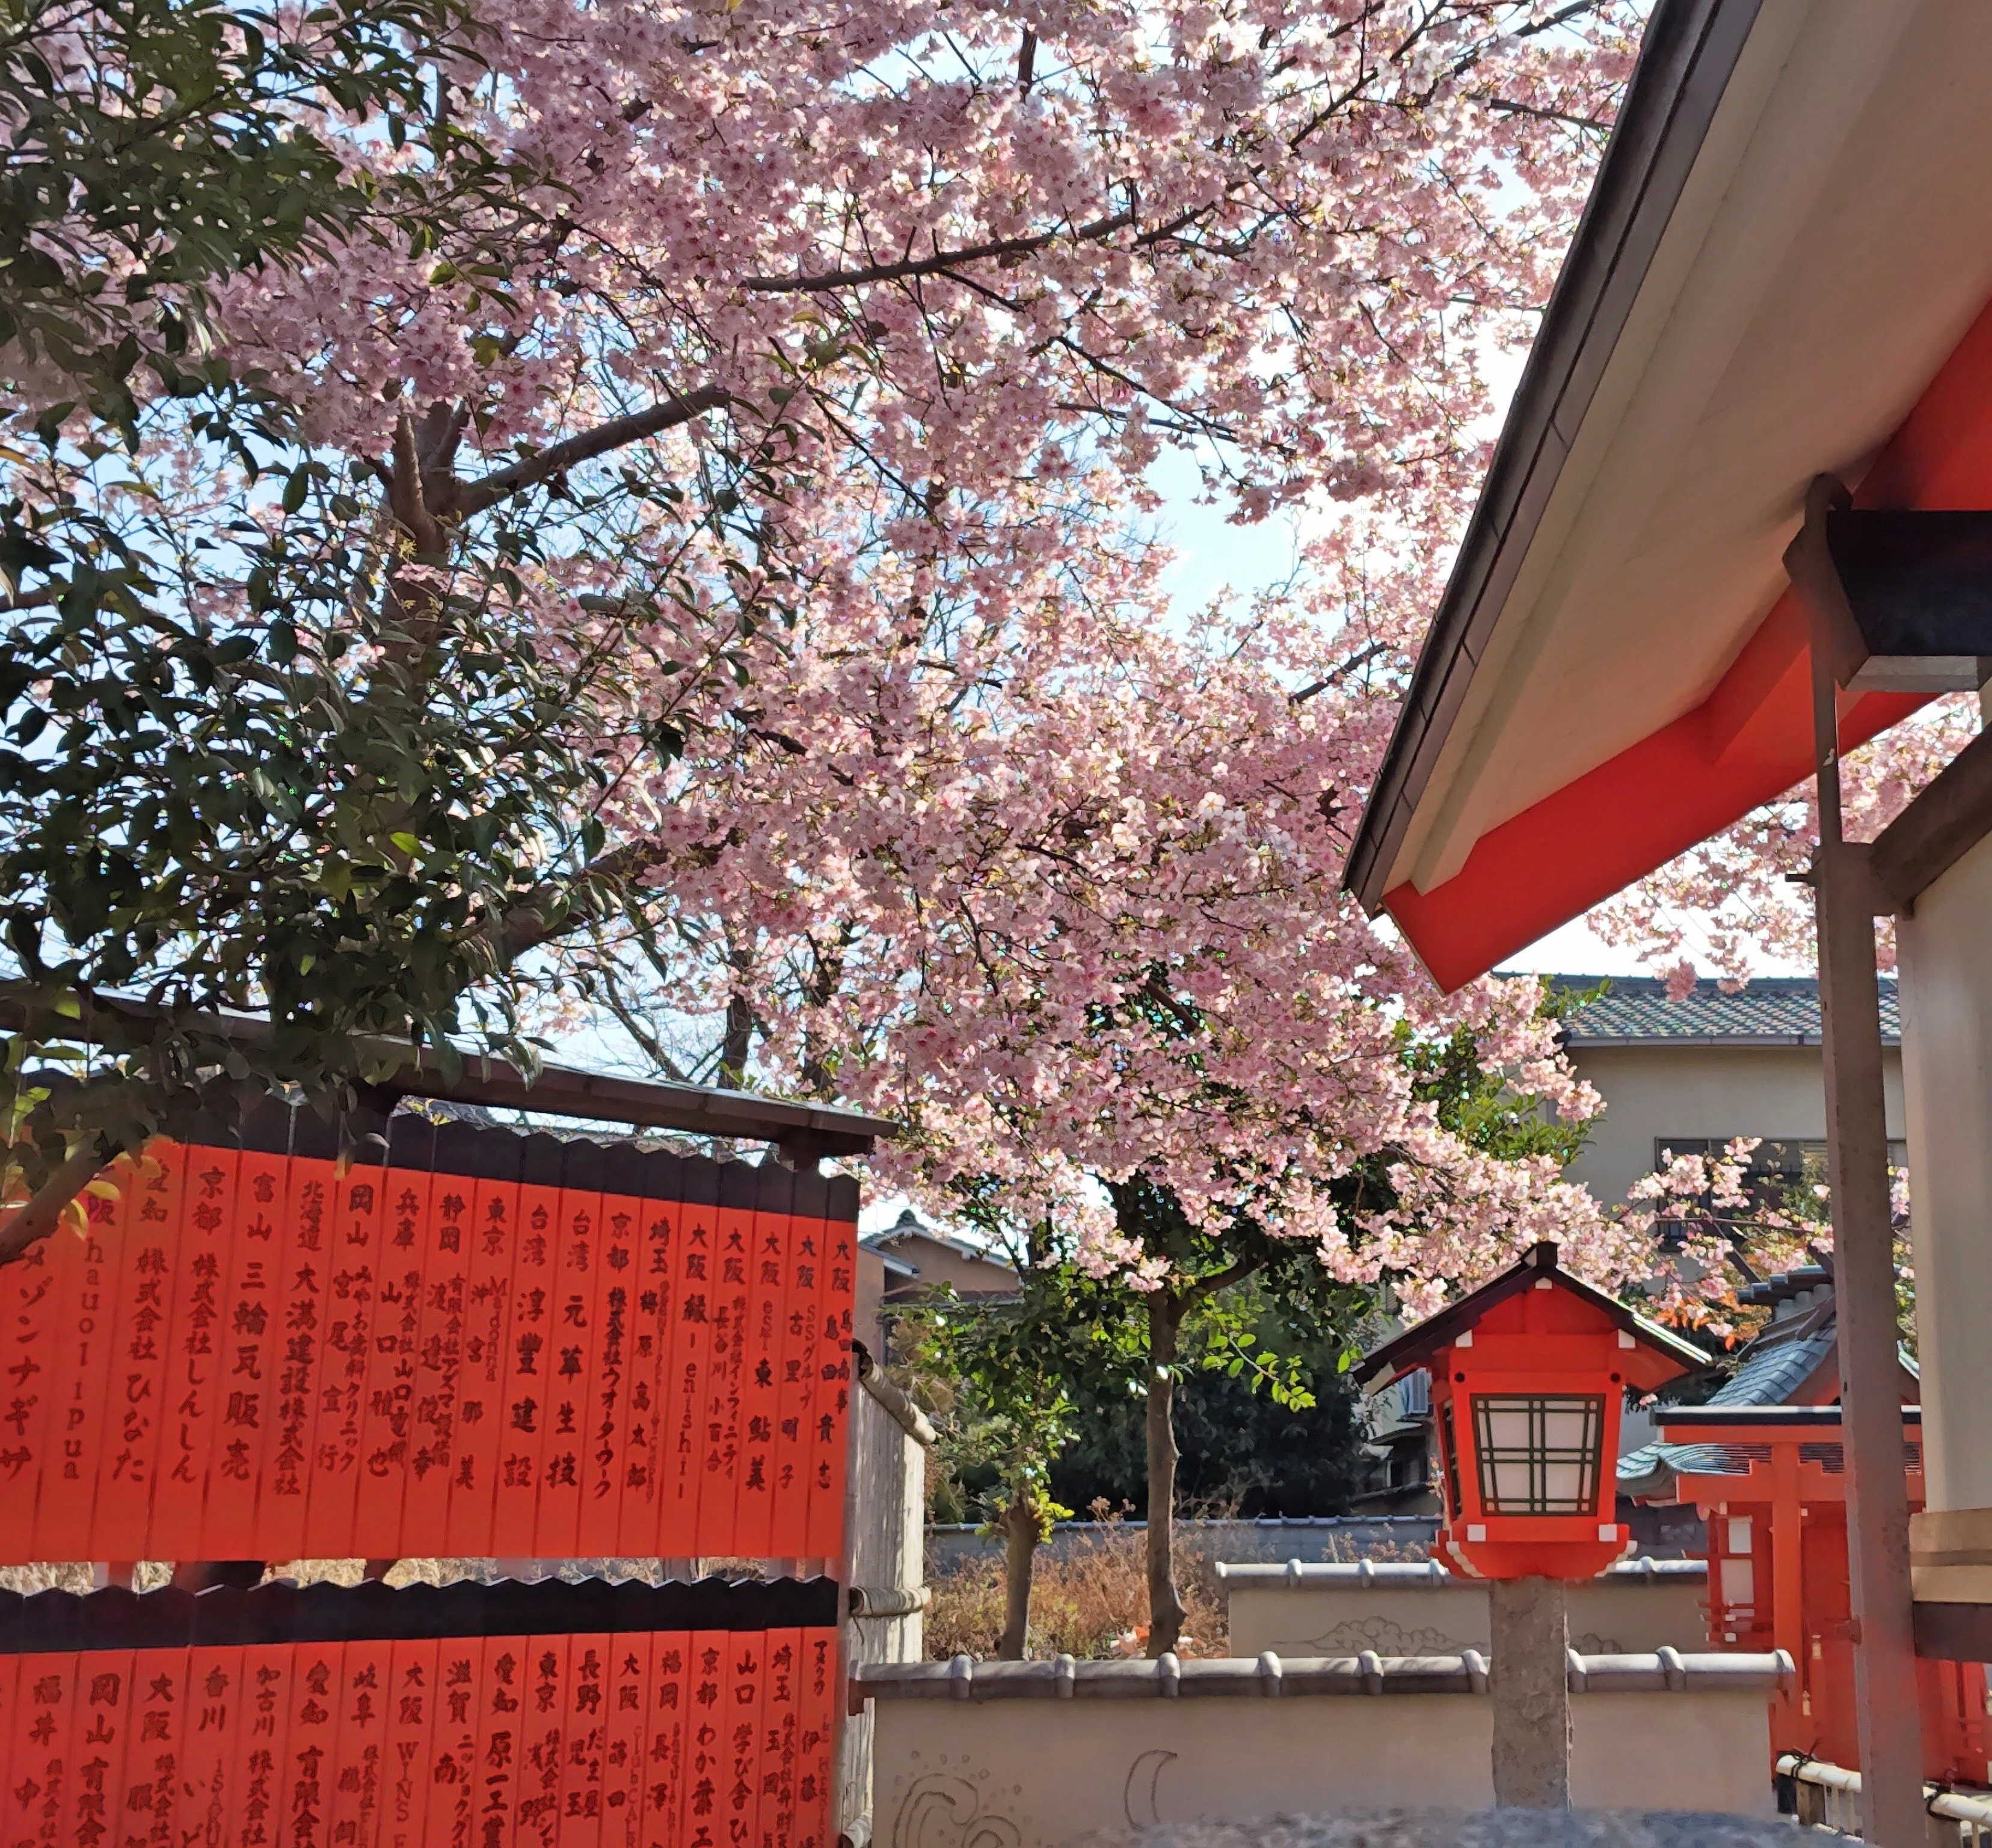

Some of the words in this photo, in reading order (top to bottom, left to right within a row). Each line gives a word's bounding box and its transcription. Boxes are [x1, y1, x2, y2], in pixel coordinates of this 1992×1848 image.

[191, 1166, 226, 1236] 京都
[247, 1171, 276, 1242] 富山
[298, 1180, 325, 1252] 北海道
[346, 1184, 374, 1248] 岡山
[390, 1186, 420, 1252] 兵庫
[439, 1193, 466, 1254] 静岡
[481, 1195, 507, 1256] 東京
[606, 1212, 632, 1274] 京都
[648, 1216, 671, 1274] 埼玉
[687, 1222, 709, 1281] 大阪
[722, 1227, 746, 1285] 大阪
[760, 1231, 781, 1287] 大阪
[796, 1234, 817, 1290] 大阪
[832, 1239, 852, 1293] 大阪
[198, 1665, 229, 1733] 香川
[252, 1664, 281, 1738] 加古川
[300, 1659, 330, 1726] 愛知
[351, 1662, 378, 1729] 岐阜
[399, 1662, 425, 1725] 大阪
[445, 1659, 473, 1724] 滋賀
[491, 1653, 519, 1716] 愛知
[535, 1651, 559, 1713] 東京
[576, 1649, 601, 1715] 長野
[619, 1652, 641, 1711] 大阪
[659, 1649, 682, 1710] 福岡
[696, 1647, 720, 1710] 京都
[734, 1649, 757, 1704] 山口
[771, 1642, 792, 1702] 埼玉
[29, 1674, 62, 1746] 福井
[85, 1672, 122, 1745] 岡山
[140, 1672, 175, 1743] 大阪
[40, 1758, 63, 1848] 株式会社
[241, 1749, 275, 1848] 株式会社
